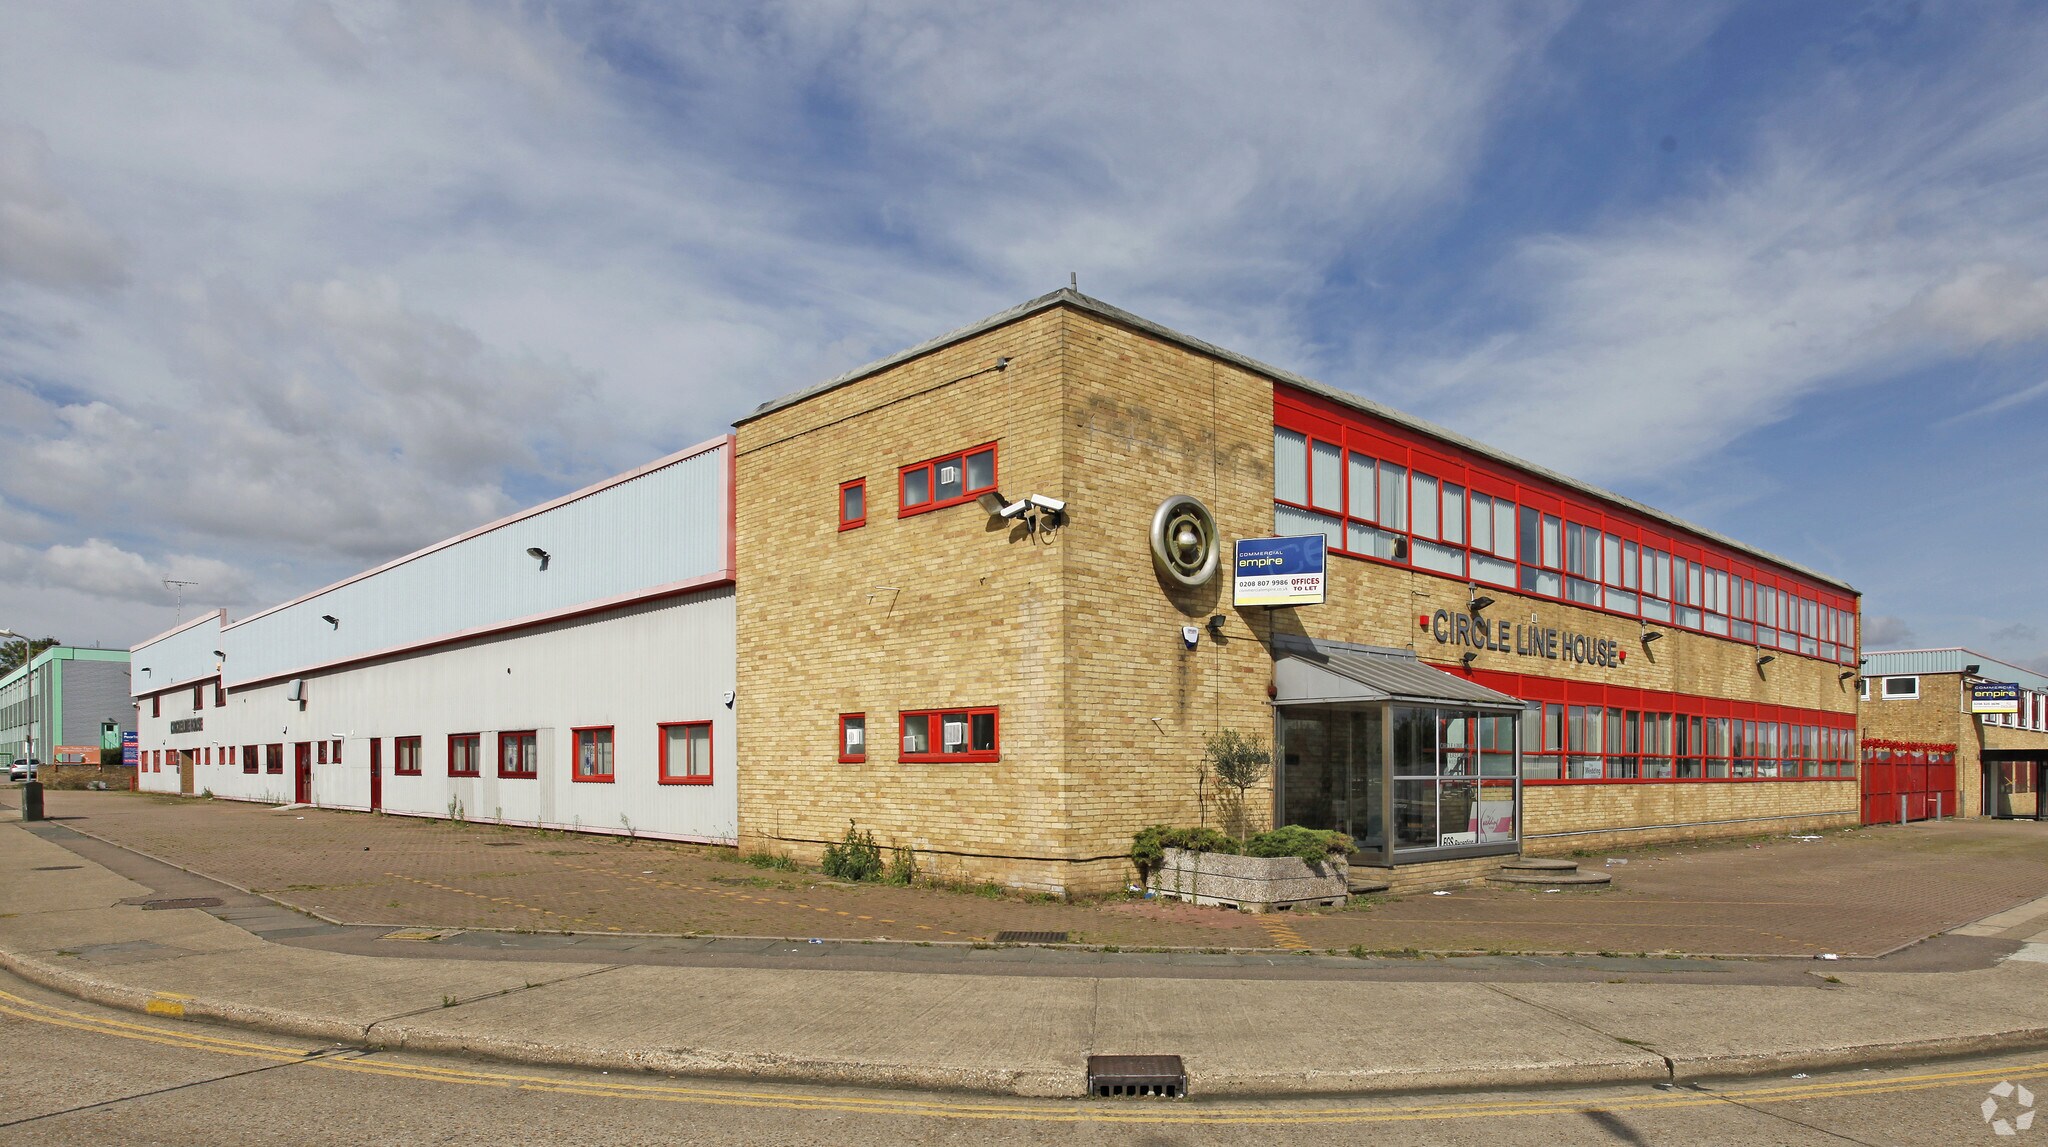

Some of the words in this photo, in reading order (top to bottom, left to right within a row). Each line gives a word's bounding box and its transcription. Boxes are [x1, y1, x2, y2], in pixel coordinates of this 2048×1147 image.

[1239, 556, 1283, 568] empire
[1433, 608, 1511, 652] CIRCLE
[1516, 623, 1558, 660] LINE
[1562, 631, 1617, 668] HOUSE
[1974, 689, 2017, 698] empire
